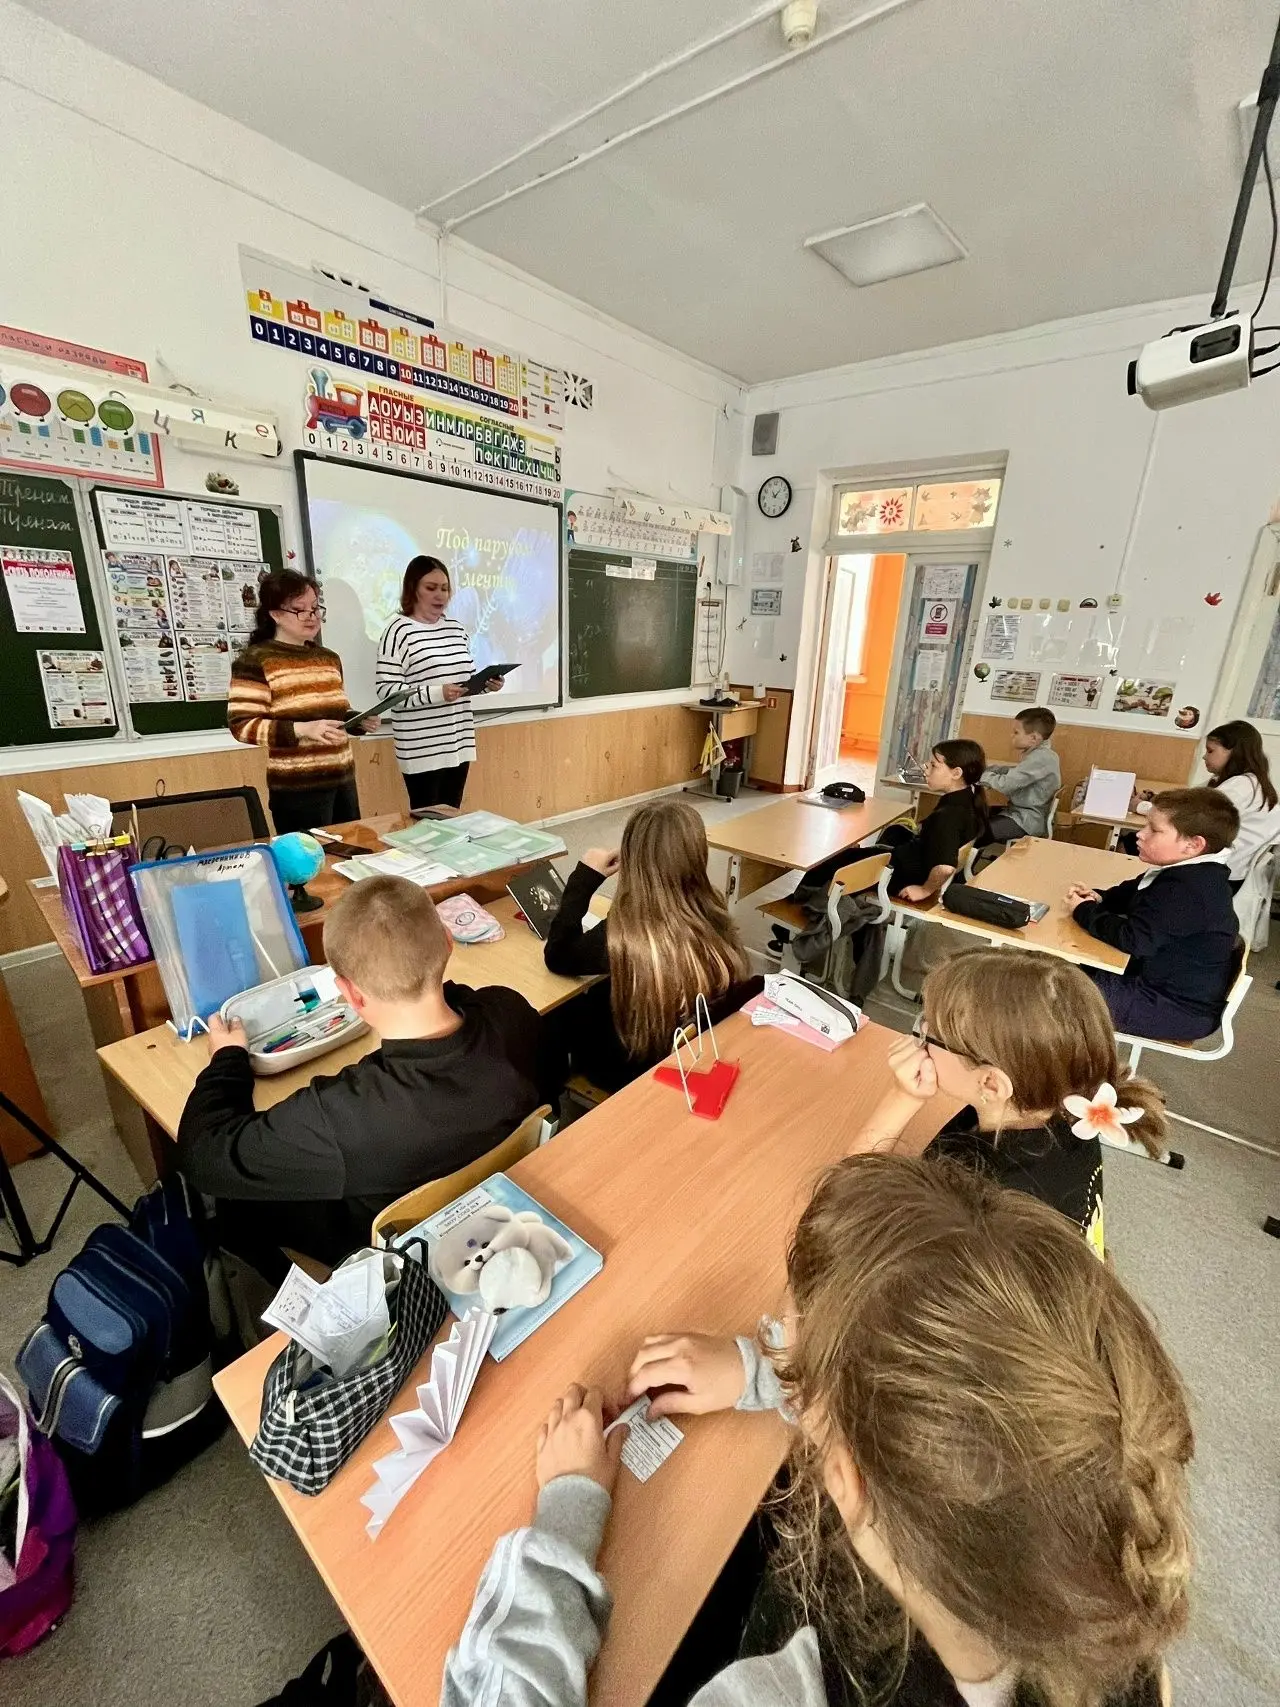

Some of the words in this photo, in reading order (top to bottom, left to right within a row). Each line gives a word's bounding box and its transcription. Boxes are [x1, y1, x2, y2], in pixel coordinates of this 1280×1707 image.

[256, 323, 263, 335] 0
[273, 329, 280, 339] 1
[289, 334, 296, 345] 2
[305, 338, 311, 349] 3
[320, 344, 327, 354] 4
[335, 348, 341, 358] 5
[349, 352, 356, 362] 6
[363, 357, 369, 366] 7
[377, 361, 383, 371] 8
[390, 365, 396, 374] 9
[401, 369, 411, 379] 10
[414, 373, 423, 382] 11
[426, 376, 435, 386] 12
[438, 379, 447, 389] 13
[450, 383, 458, 392] 14
[460, 386, 469, 396] 15
[471, 390, 479, 399] 16
[481, 393, 488, 402] 17
[490, 397, 498, 406] 18
[500, 400, 508, 408] 19
[509, 403, 517, 411] 20
[379, 386, 414, 401] ГЛАСНЫЕ
[480, 416, 514, 430] СОГЛАСНЫЕ
[309, 433, 315, 444] 0
[327, 438, 331, 448] 1
[342, 441, 348, 451] 2
[358, 444, 363, 454] 3
[373, 448, 378, 458] 4
[387, 451, 392, 460] 5
[401, 454, 406, 464] 6
[415, 457, 419, 466] 7
[428, 460, 432, 469] 8
[441, 463, 445, 472] 9
[451, 466, 459, 475] 10
[463, 469, 471, 478] 11
[474, 472, 482, 481] 12
[485, 475, 493, 483] 13
[496, 477, 503, 486] 14
[506, 480, 513, 488] 15
[516, 482, 523, 490] 16
[535, 486, 542, 494] 18
[544, 488, 551, 496] 19
[436, 527, 470, 550] Под
